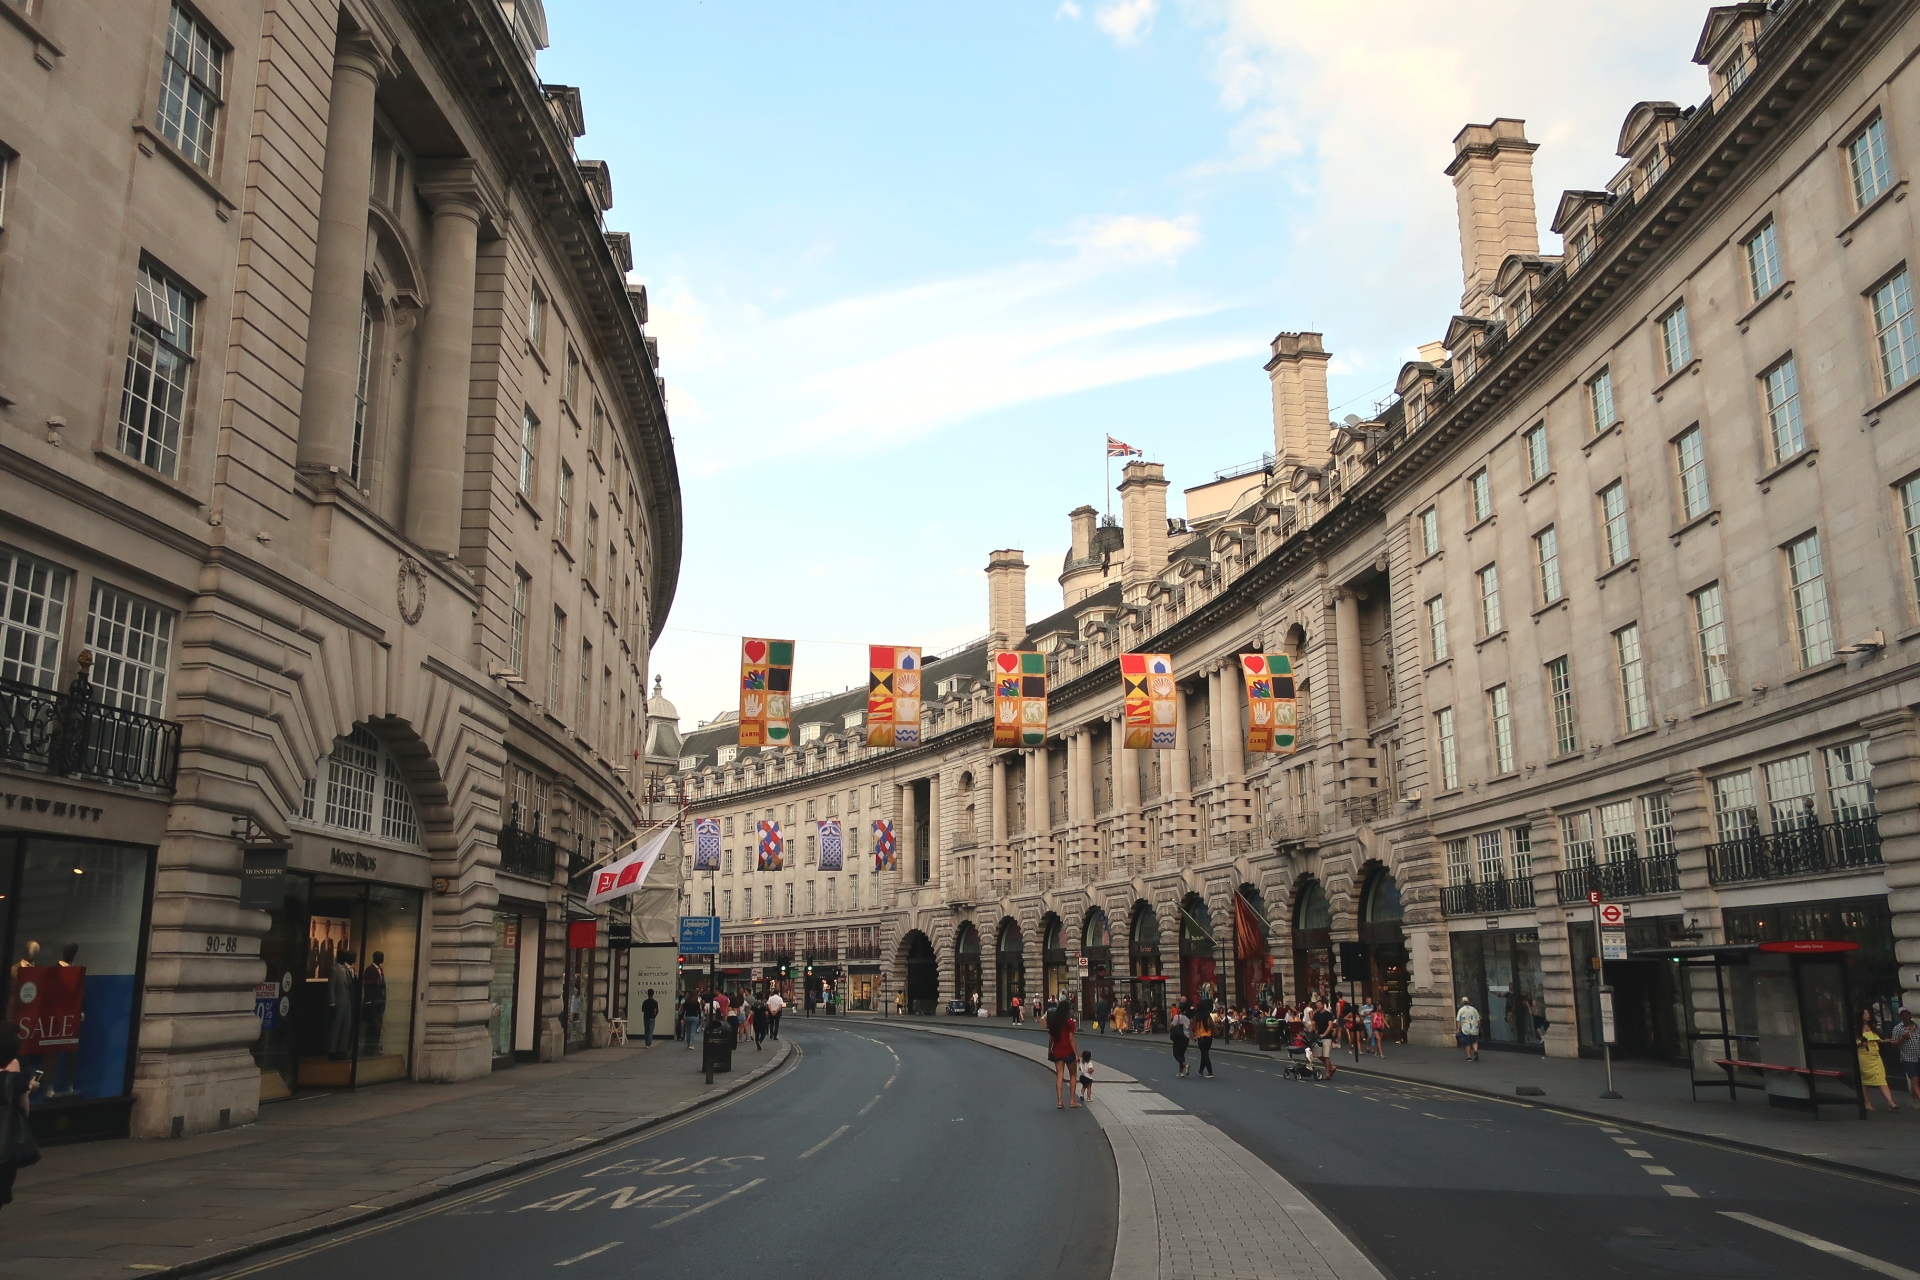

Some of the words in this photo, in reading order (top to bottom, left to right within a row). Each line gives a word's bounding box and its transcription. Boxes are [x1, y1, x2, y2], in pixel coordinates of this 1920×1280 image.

[1590, 892, 1599, 903] E
[206, 935, 237, 953] 90-88
[17, 1014, 75, 1040] SALE
[582, 1155, 767, 1178] BUS
